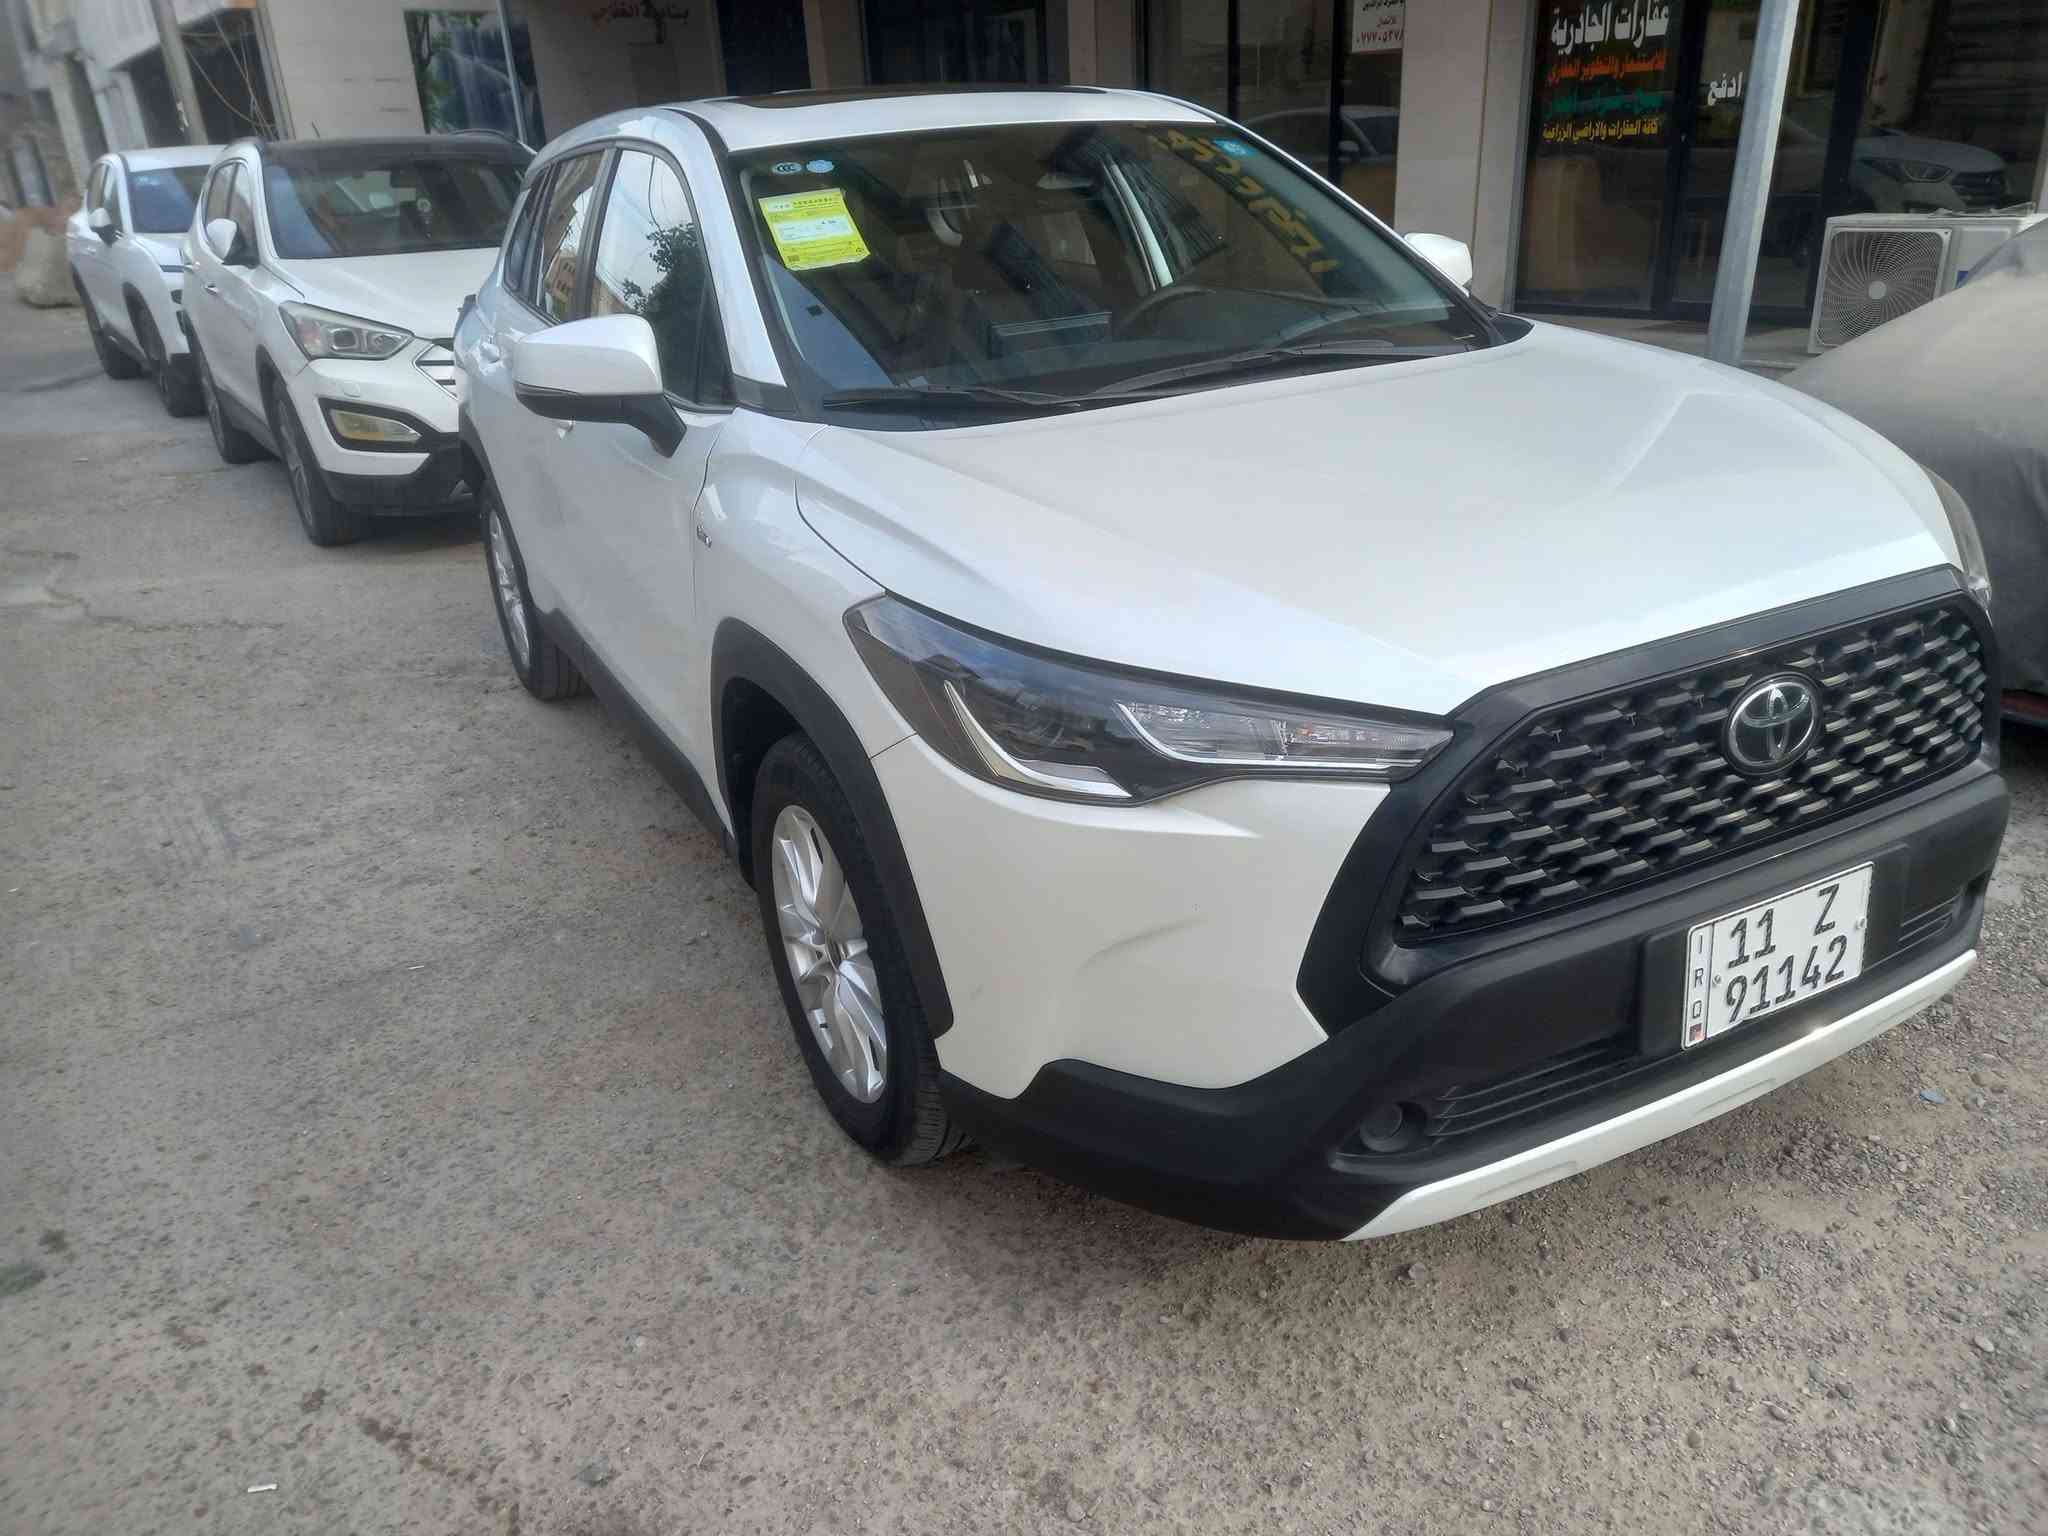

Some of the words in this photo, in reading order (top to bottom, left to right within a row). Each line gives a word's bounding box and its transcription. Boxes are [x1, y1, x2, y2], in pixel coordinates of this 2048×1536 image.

[1551, 1, 1613, 55] الجادرية
[1614, 0, 1670, 48] عقارات
[1707, 72, 1743, 106] ادفع
[1608, 119, 1641, 140] العقارات
[1728, 908, 1776, 969] 11
[1813, 884, 1840, 936] Z
[1726, 934, 1848, 1023] 91142
